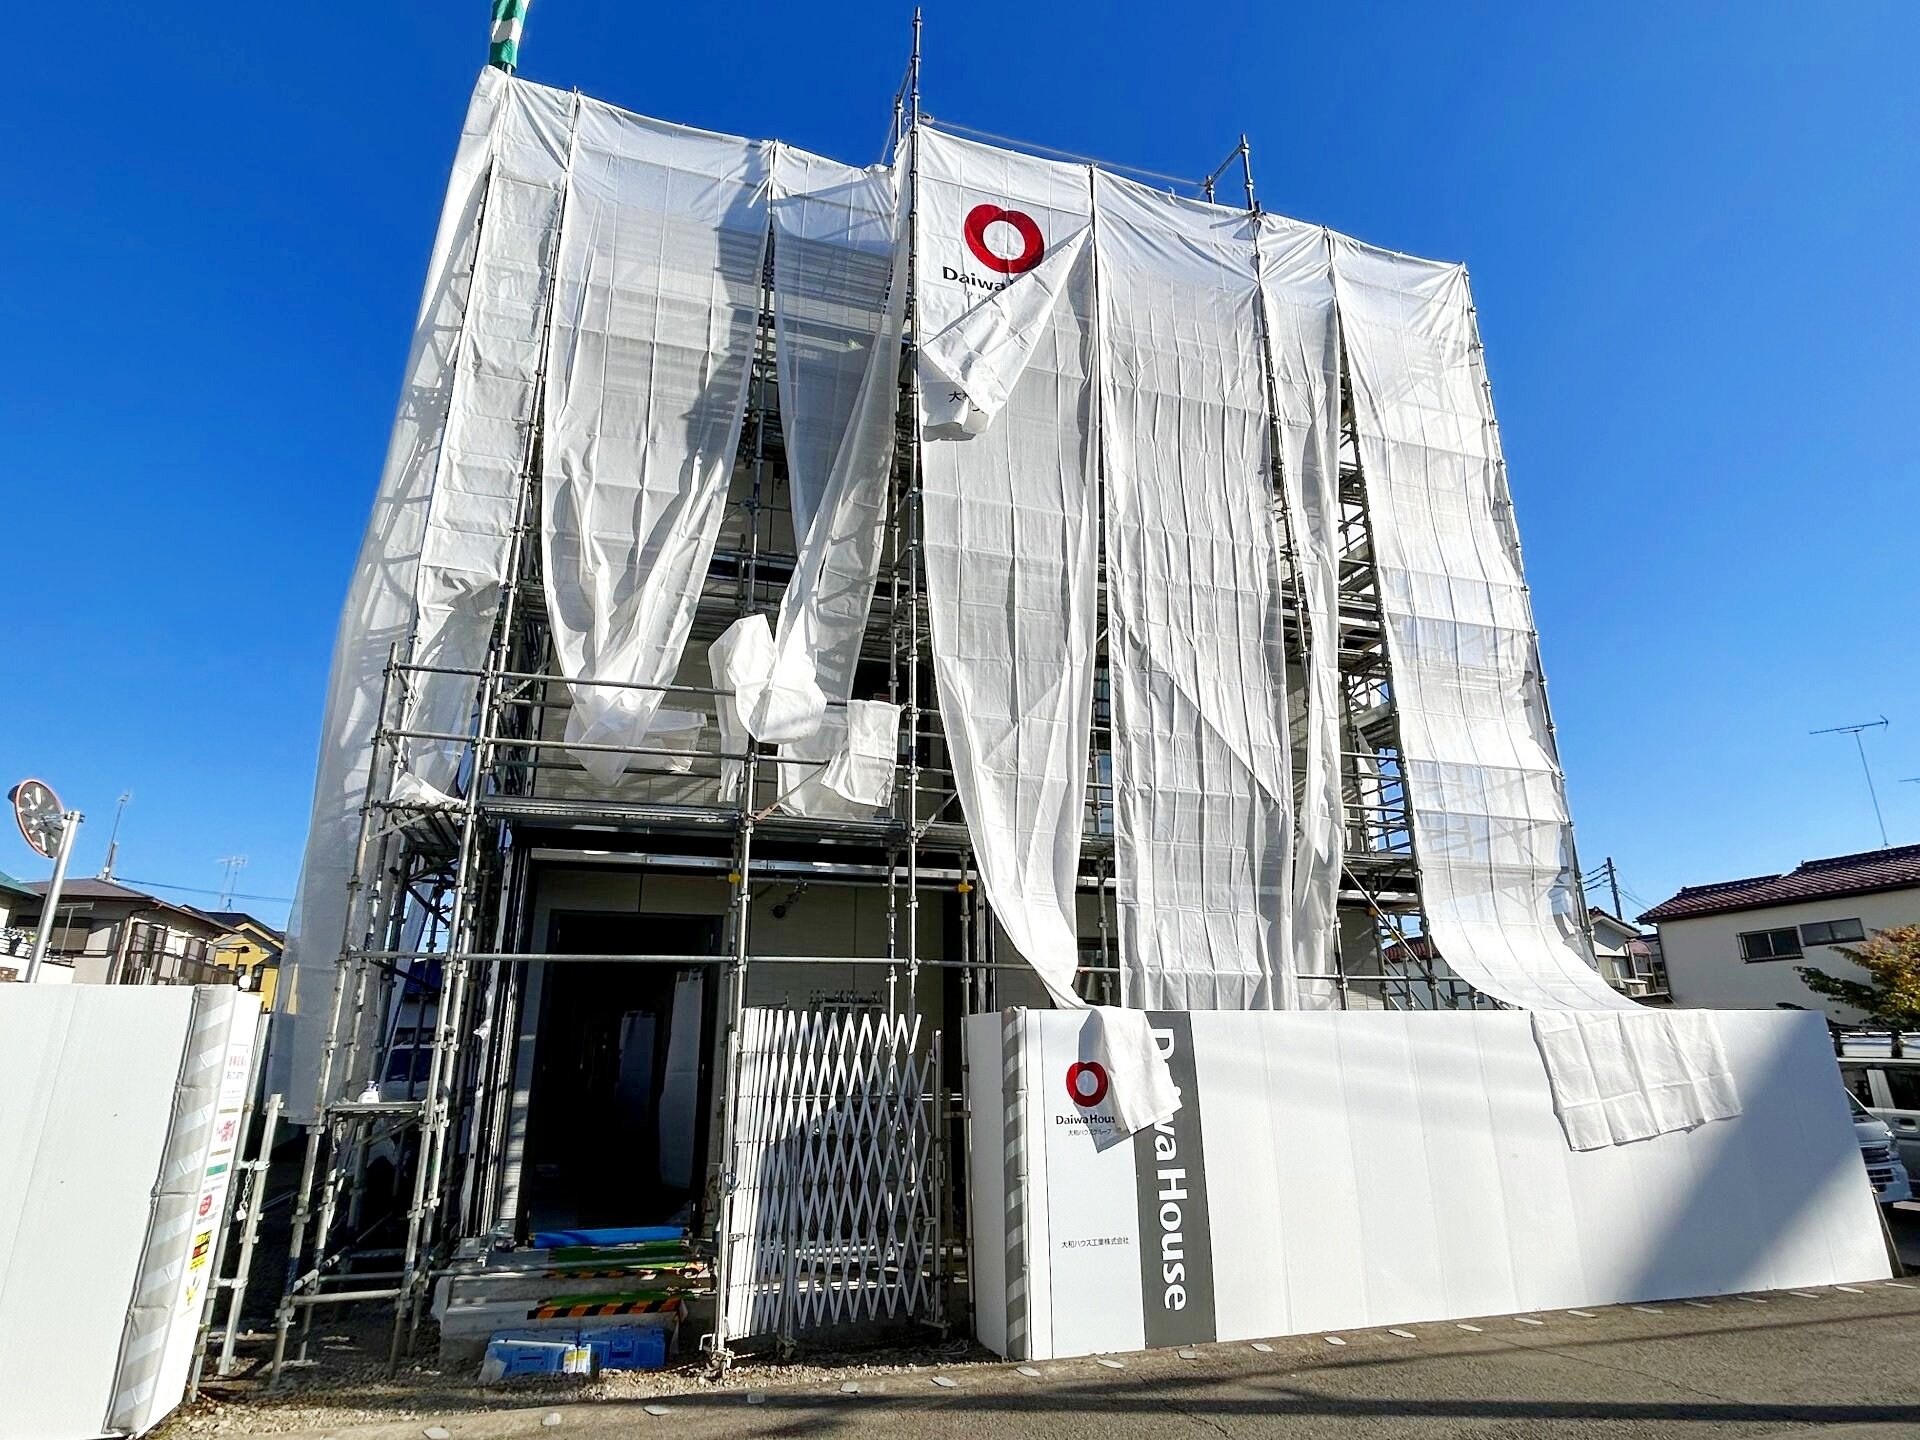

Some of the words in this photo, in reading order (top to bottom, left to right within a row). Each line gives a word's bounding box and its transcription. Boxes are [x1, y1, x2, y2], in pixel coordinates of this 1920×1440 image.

[943, 265, 1006, 292] Daiwa
[1089, 1114, 1116, 1124] Hous
[1061, 1236, 1129, 1249] 大和ハウス工業株式会社
[1156, 1168, 1188, 1312] House
